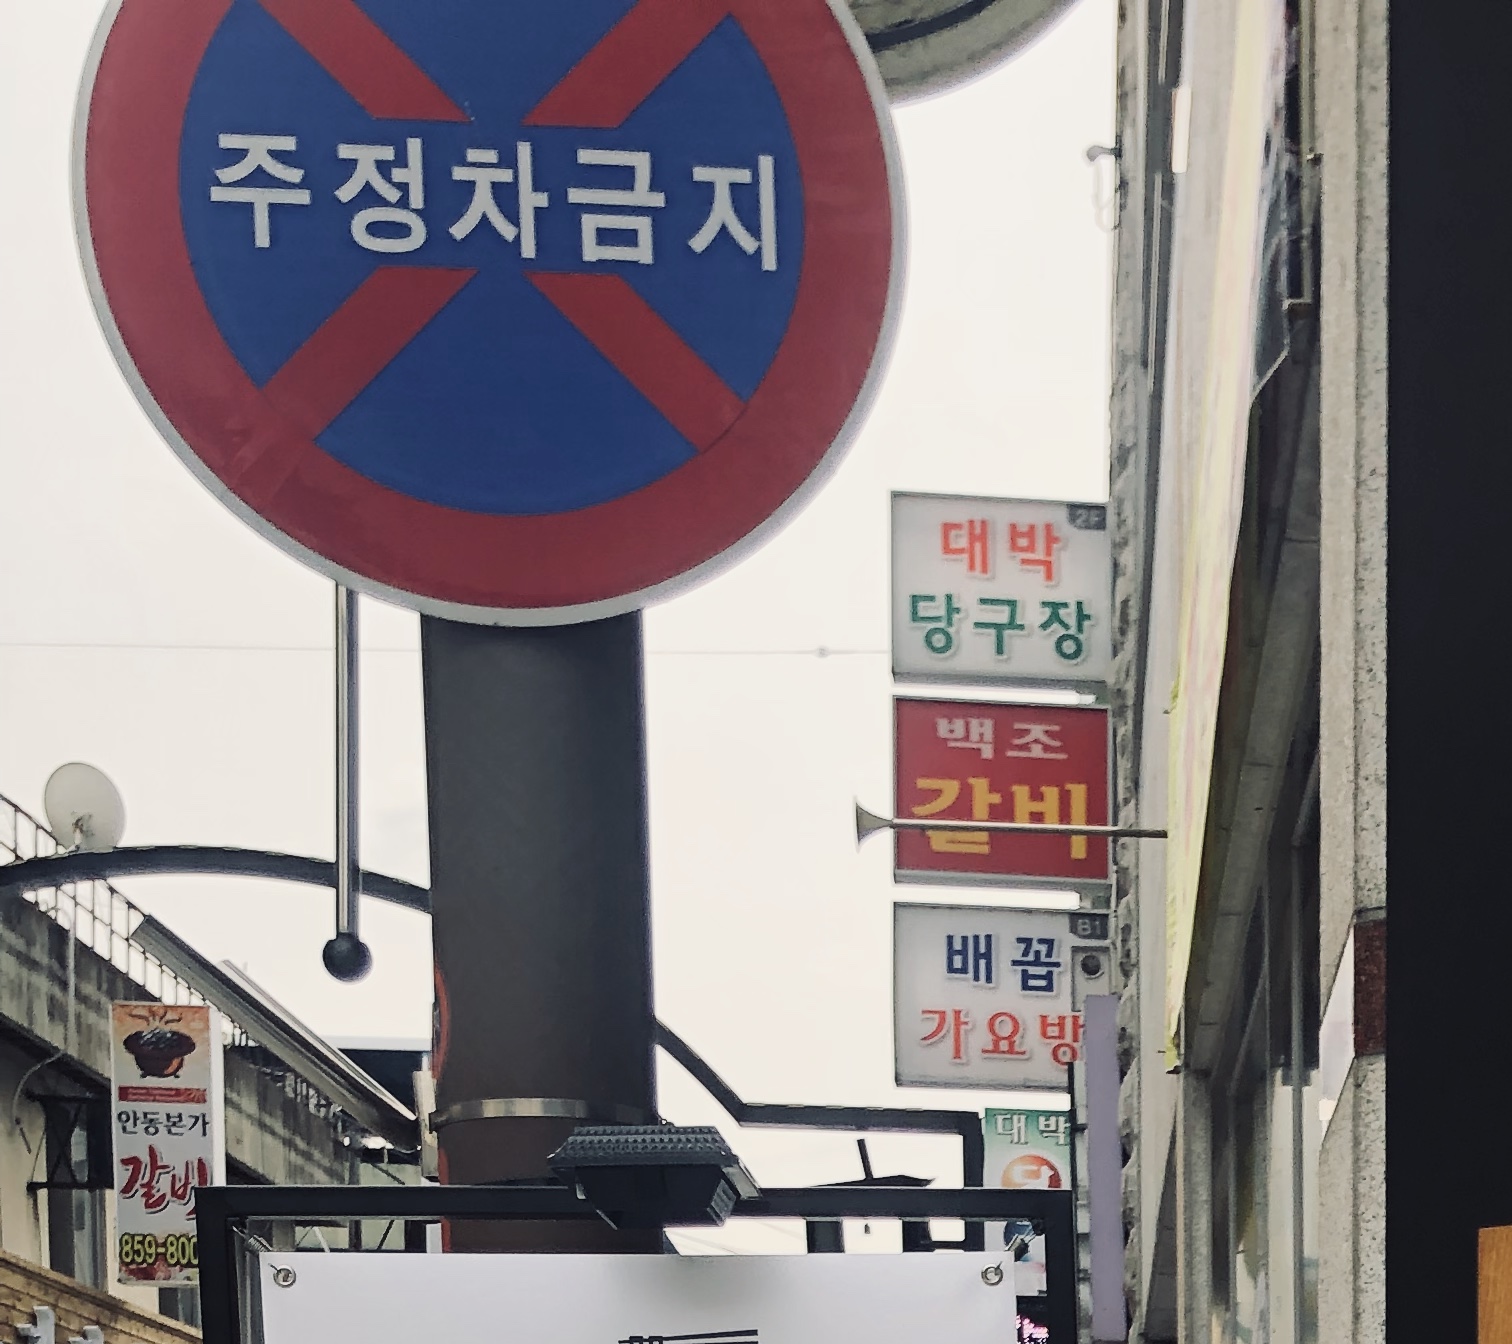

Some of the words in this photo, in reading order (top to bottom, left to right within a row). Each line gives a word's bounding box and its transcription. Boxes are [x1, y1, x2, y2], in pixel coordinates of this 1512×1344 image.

[210, 129, 781, 272] 주정차금지
[939, 518, 1061, 583] 대박
[908, 593, 1092, 662] 당구장
[935, 717, 1069, 761] 백조
[911, 776, 1089, 860] 갈비
[1076, 918, 1102, 936] B1
[945, 933, 1062, 994] 배꼽
[920, 1008, 1086, 1065] 가요방
[118, 1110, 209, 1137] 안동본가
